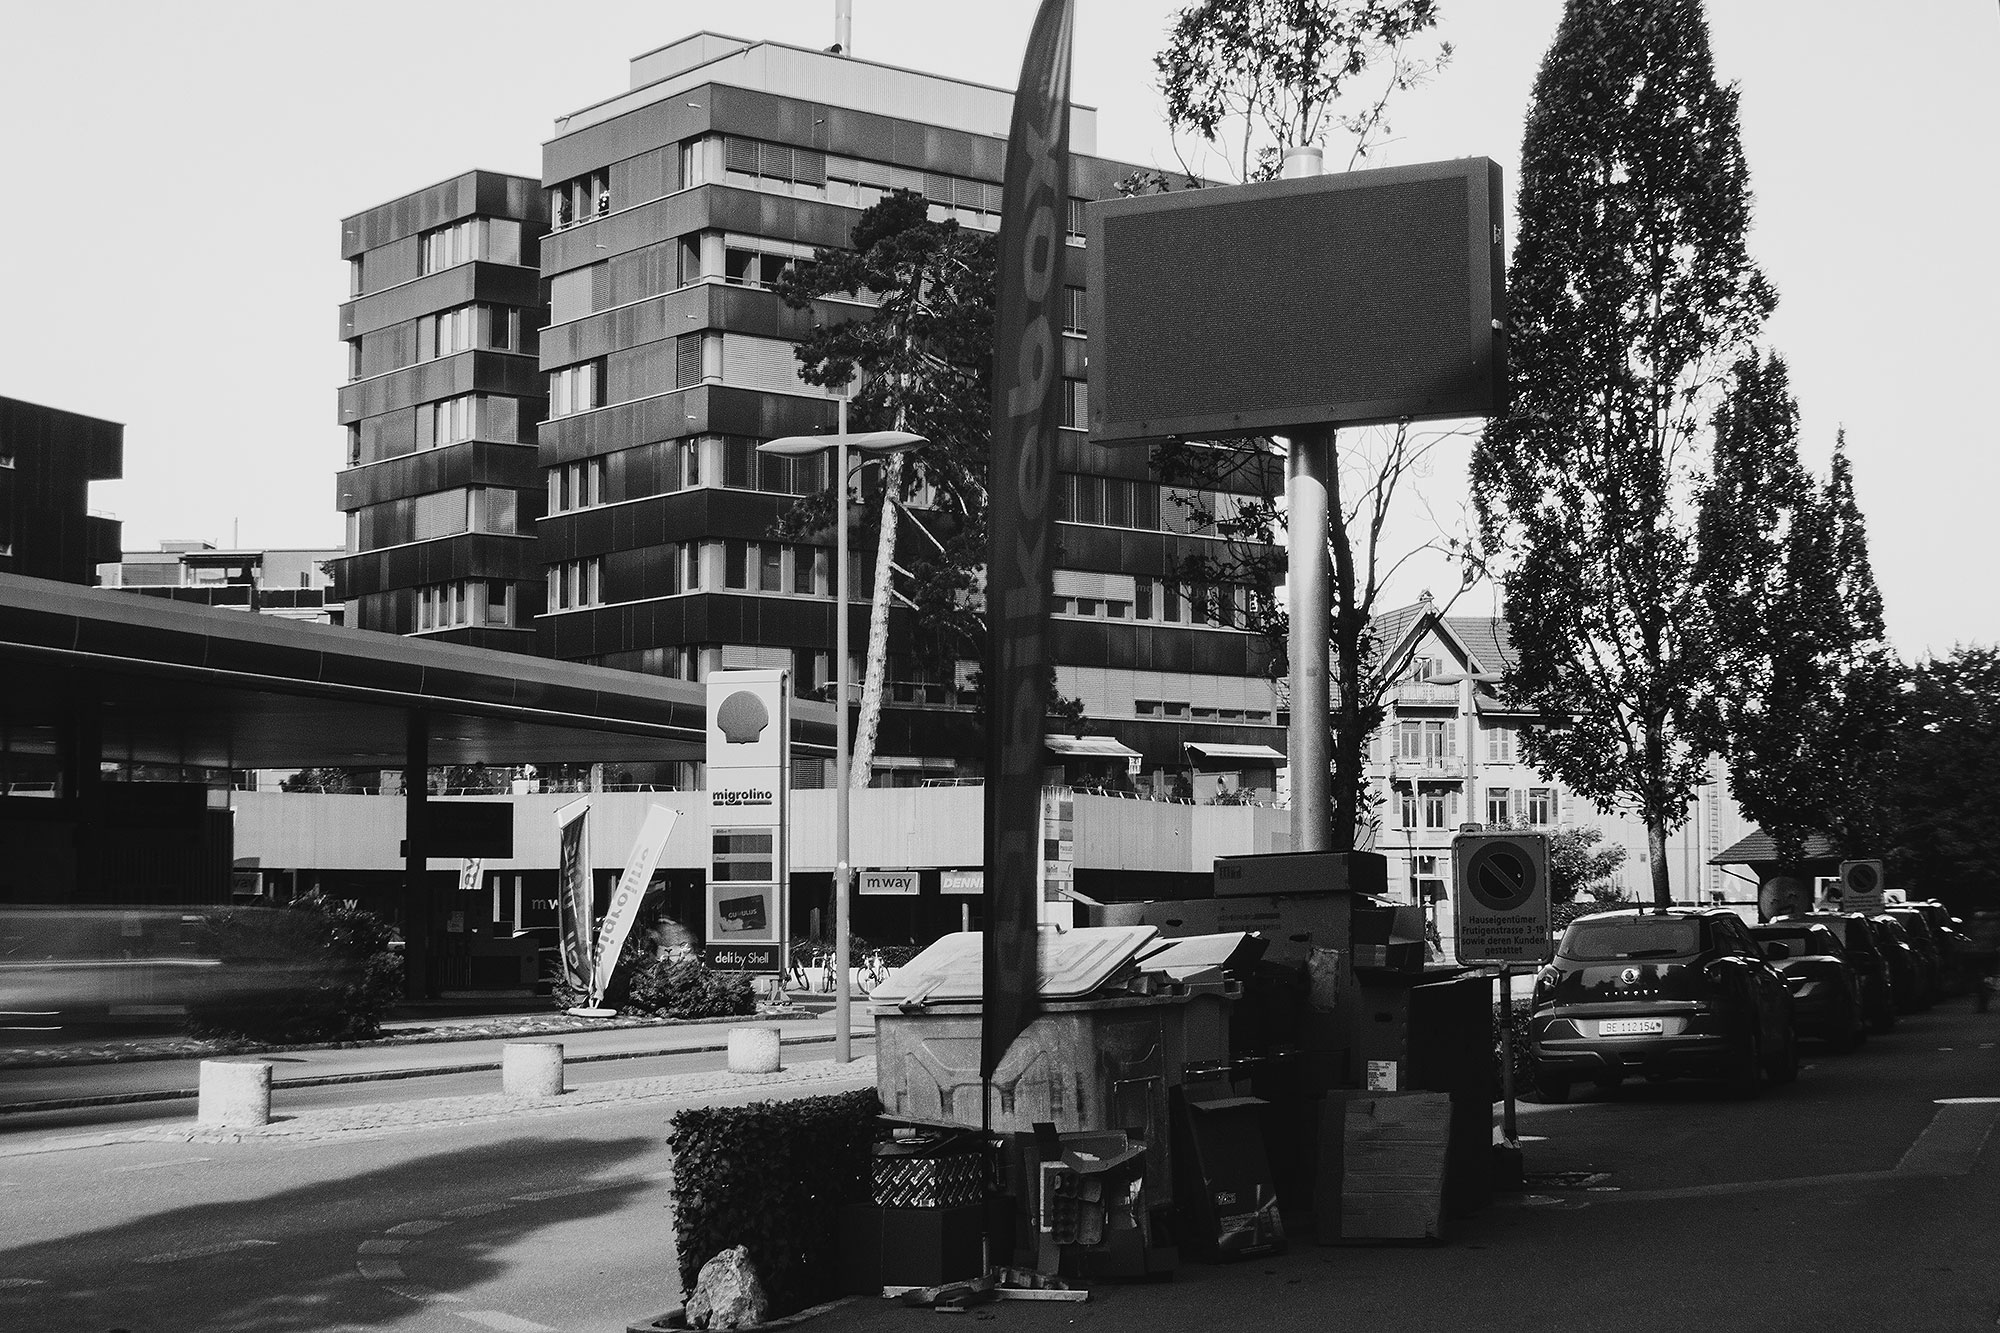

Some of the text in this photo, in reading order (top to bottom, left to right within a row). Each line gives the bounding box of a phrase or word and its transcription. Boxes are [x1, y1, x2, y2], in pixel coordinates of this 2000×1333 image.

[1001, 120, 1058, 775] bikebox
[713, 788, 772, 803] migrolino
[943, 877, 983, 888] DENN
[1469, 914, 1537, 926] Hauseigentümer
[1462, 925, 1545, 936] Frutigenstrasse 3-19
[1462, 935, 1546, 946] sowie deren Kunden
[1484, 945, 1523, 956] gestattet
[714, 952, 769, 966] deli by Shell
[1606, 1023, 1617, 1033] BE
